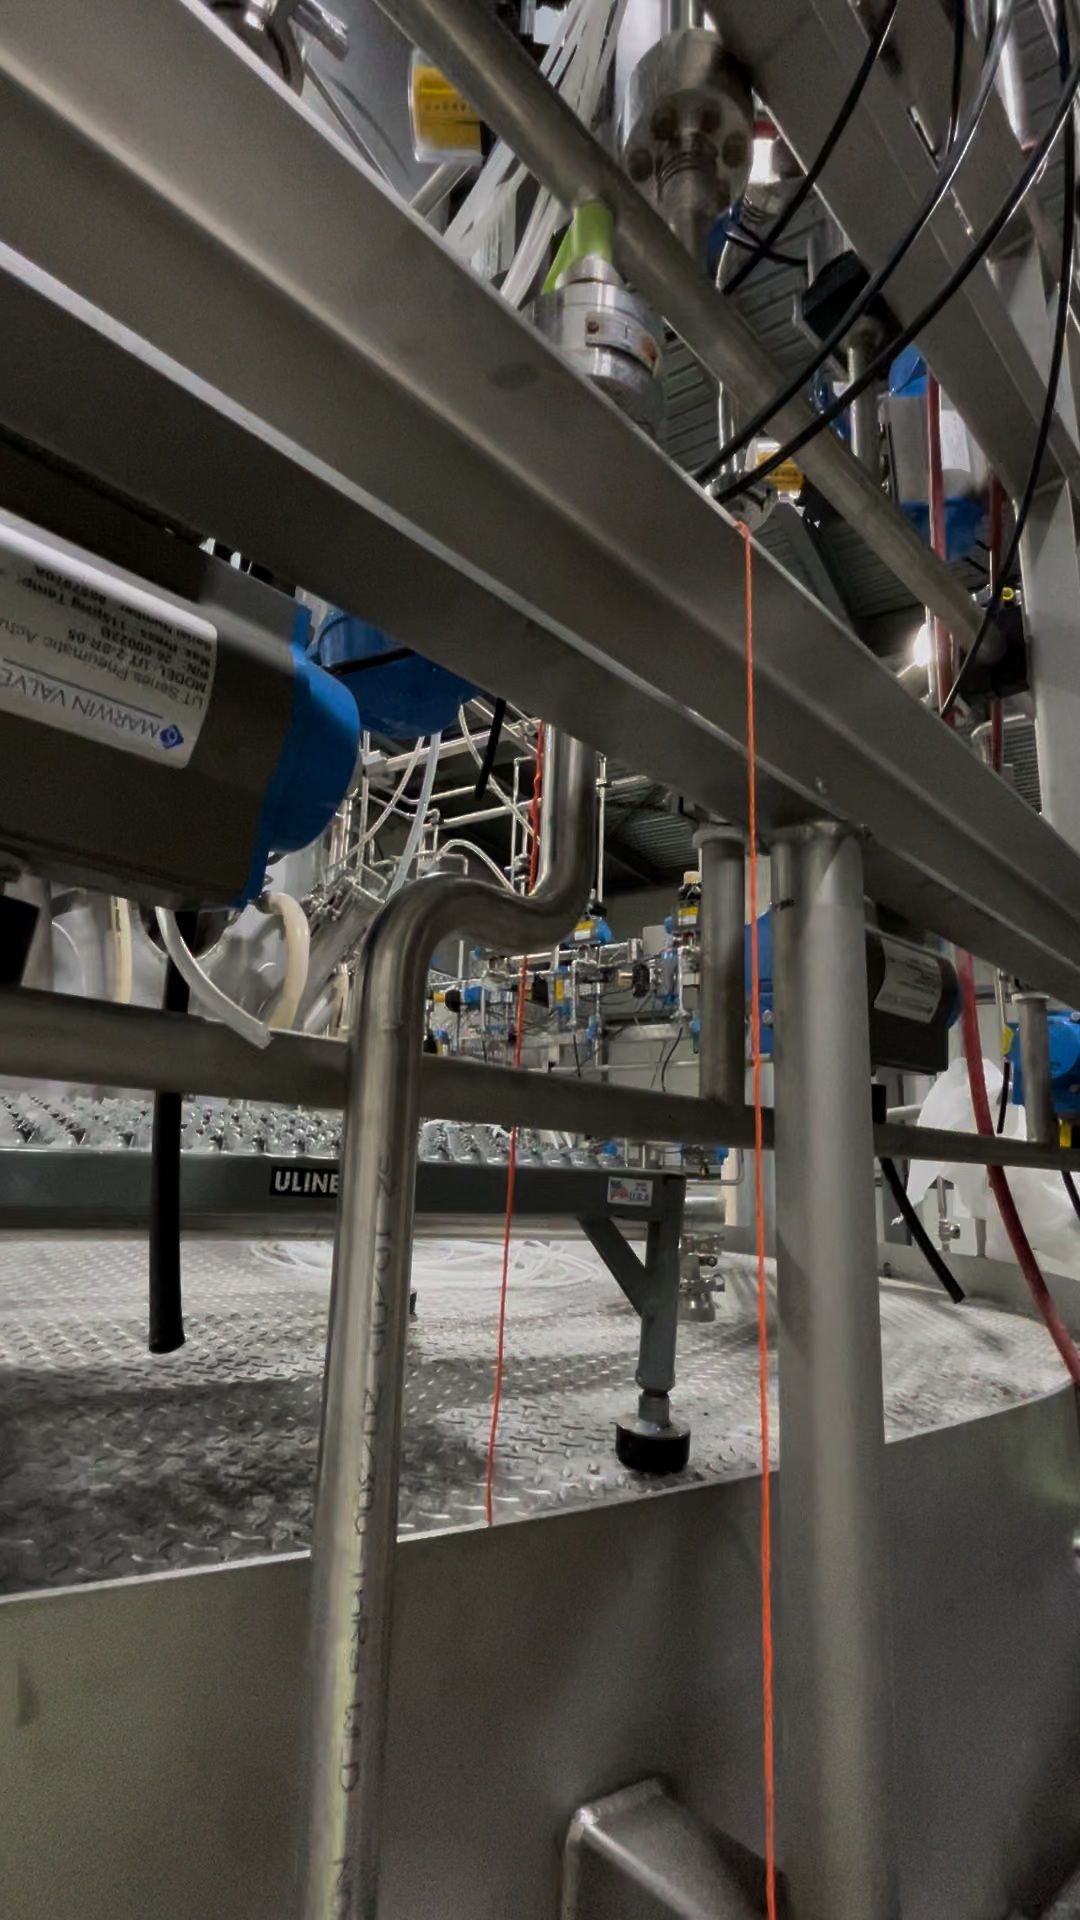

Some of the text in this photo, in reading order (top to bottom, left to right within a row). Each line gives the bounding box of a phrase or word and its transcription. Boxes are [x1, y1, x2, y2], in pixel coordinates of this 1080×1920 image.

[42, 635, 128, 681] Pneumatic
[133, 670, 180, 699] Series
[71, 695, 160, 738] MARWIN
[275, 1170, 340, 1194] ULINE
